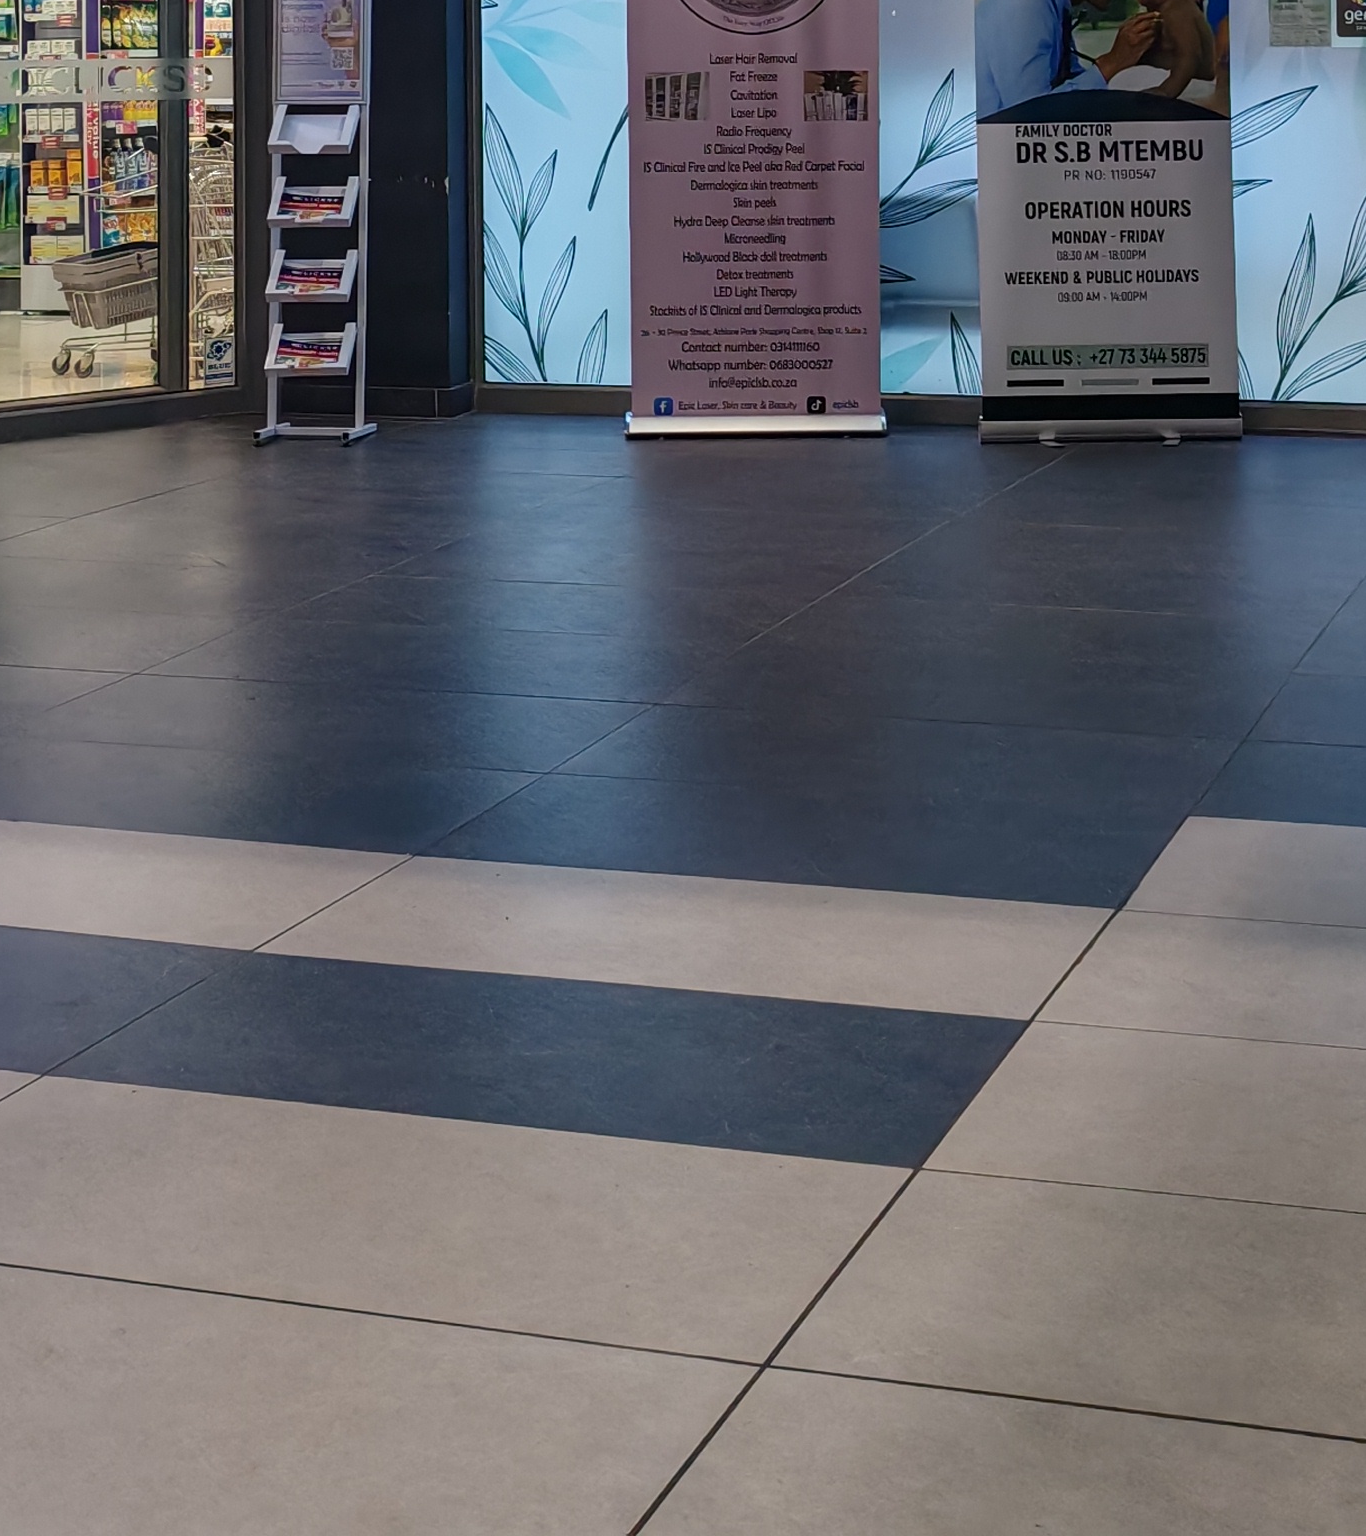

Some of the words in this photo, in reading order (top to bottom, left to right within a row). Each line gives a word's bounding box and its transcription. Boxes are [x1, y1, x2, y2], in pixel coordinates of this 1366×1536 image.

[709, 53, 733, 64] Laser
[736, 53, 755, 64] Hair
[758, 52, 797, 64] Removal
[730, 71, 746, 82] Fat
[748, 71, 778, 82] Freeze
[730, 90, 778, 101] Cavitation
[731, 108, 754, 119] Laser
[757, 108, 777, 120] Lipo
[716, 126, 743, 137] Radio
[745, 126, 792, 139] Frequency
[1015, 125, 1059, 138] FAMILY
[1063, 124, 1112, 137] DOCTOR
[714, 144, 746, 155] Clinical
[748, 144, 783, 156] Prodigy
[785, 143, 805, 154] Peel
[1016, 142, 1047, 164] DR
[1054, 141, 1091, 163] S.B
[1099, 139, 1203, 163] MTEMBU
[643, 162, 652, 173] IS
[654, 162, 686, 173] Clinical
[688, 162, 706, 173] Fire
[707, 162, 726, 173] and
[727, 162, 740, 172] Ice
[742, 161, 762, 172] Peel
[764, 161, 783, 172] aka
[785, 161, 803, 172] Red
[805, 161, 836, 173] Carpet
[838, 160, 864, 172] Facial
[1064, 170, 1080, 182] PR
[1085, 169, 1106, 181] NO:
[690, 180, 748, 192] Dermalogica
[750, 180, 767, 190] skin
[769, 179, 818, 190] treatments
[733, 197, 752, 209] Skin
[754, 198, 777, 211] peels
[1025, 201, 1124, 220] OPERATION
[1130, 199, 1191, 218] HOURS
[674, 216, 703, 229] Hydra
[705, 216, 729, 230] Deep
[731, 216, 765, 227] Cleanse
[767, 216, 785, 227] skin
[787, 215, 835, 227] treatments
[724, 233, 786, 247] Microneedling
[1052, 230, 1107, 244] MONDAY
[1119, 229, 1165, 243] FRIDAY
[682, 251, 731, 265] Hollywood
[778, 251, 828, 262] treatments
[1056, 250, 1082, 261] 08:30
[1084, 250, 1099, 261] AM
[716, 269, 743, 280] Detox
[745, 269, 794, 280] treatments
[1004, 271, 1069, 285] WEEKEND
[1073, 271, 1082, 284] &
[1086, 270, 1133, 284] PUBLIC
[1136, 269, 1199, 283] HOLIDAYS
[713, 286, 732, 298] LED
[735, 286, 757, 300] Light
[759, 286, 797, 300] Therapy
[1058, 292, 1083, 302] 09:00
[1086, 291, 1100, 302] AM
[1110, 291, 1148, 302] 14:00PM
[649, 305, 686, 317] Stockists
[688, 305, 698, 317] of
[710, 305, 742, 316] Clinical
[744, 305, 762, 316] and
[764, 304, 822, 318] Dermalogica
[823, 304, 862, 317] products
[681, 341, 722, 353] Contact
[724, 341, 768, 353] number:
[1011, 349, 1048, 366] CALL
[1089, 348, 1115, 364] +27
[1118, 348, 1135, 364] 73
[1140, 347, 1167, 363] 344
[1171, 346, 1206, 363] 5875
[668, 360, 721, 373] Whatsapp
[723, 360, 768, 371] number:
[769, 359, 833, 371] 0683000527
[678, 401, 695, 411] Epic
[722, 401, 739, 410] Skin
[760, 401, 767, 410] &
[768, 400, 797, 411] Beauty
